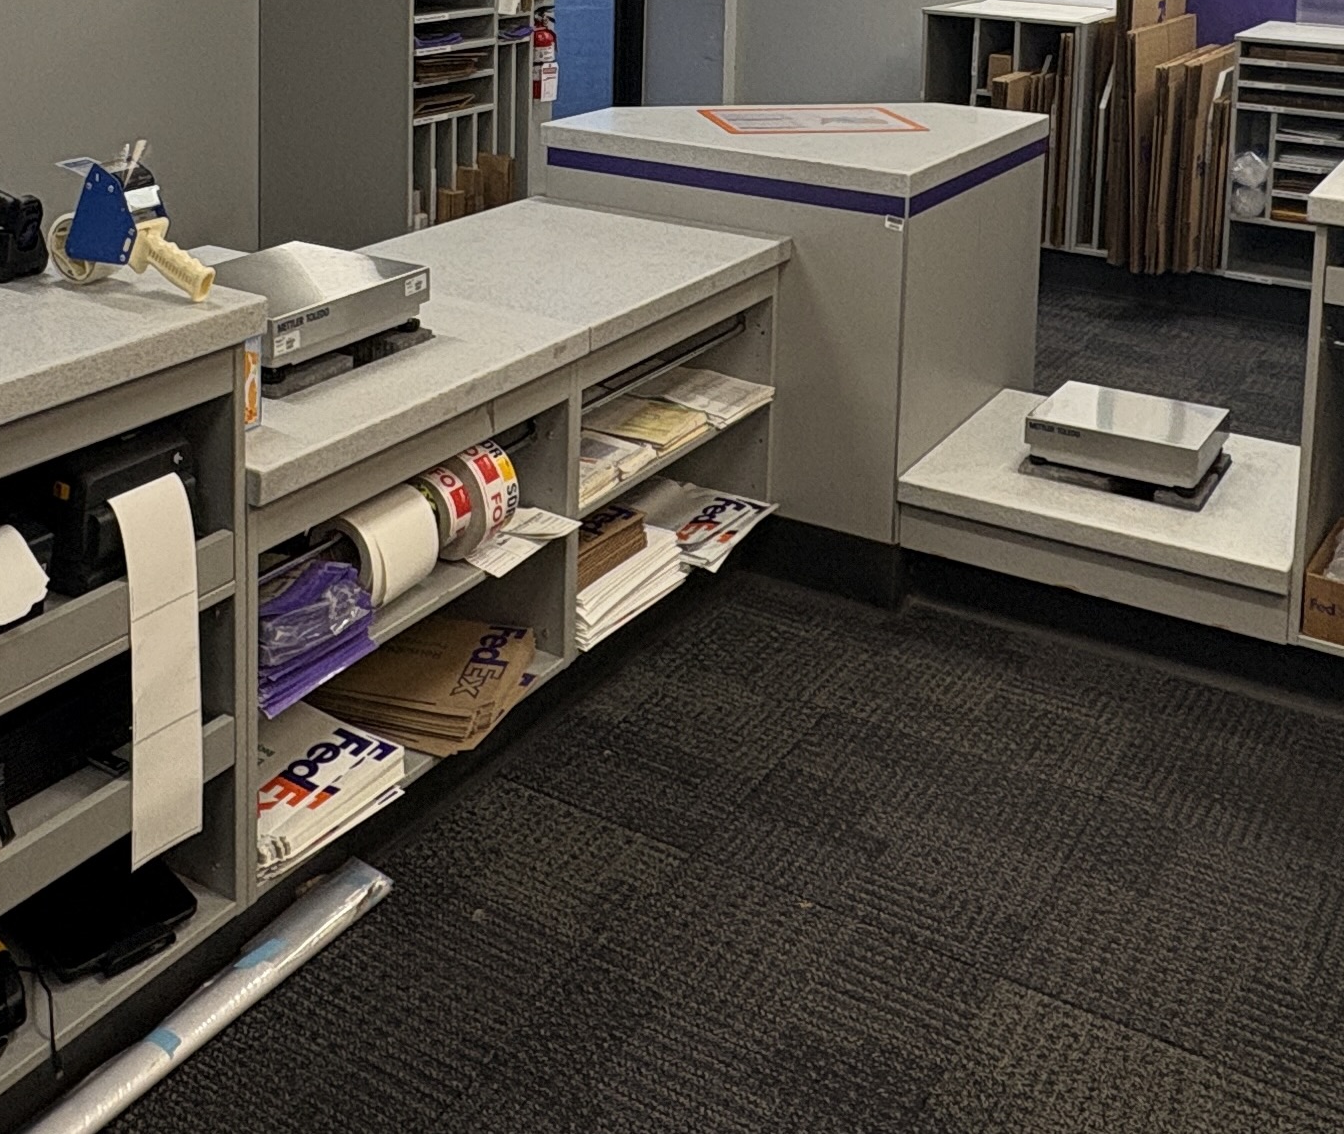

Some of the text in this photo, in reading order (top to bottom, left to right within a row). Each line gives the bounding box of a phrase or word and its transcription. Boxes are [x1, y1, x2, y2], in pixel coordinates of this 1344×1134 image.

[277, 317, 304, 334] METTLER
[675, 497, 747, 541] FedE
[450, 626, 528, 699] FedEx
